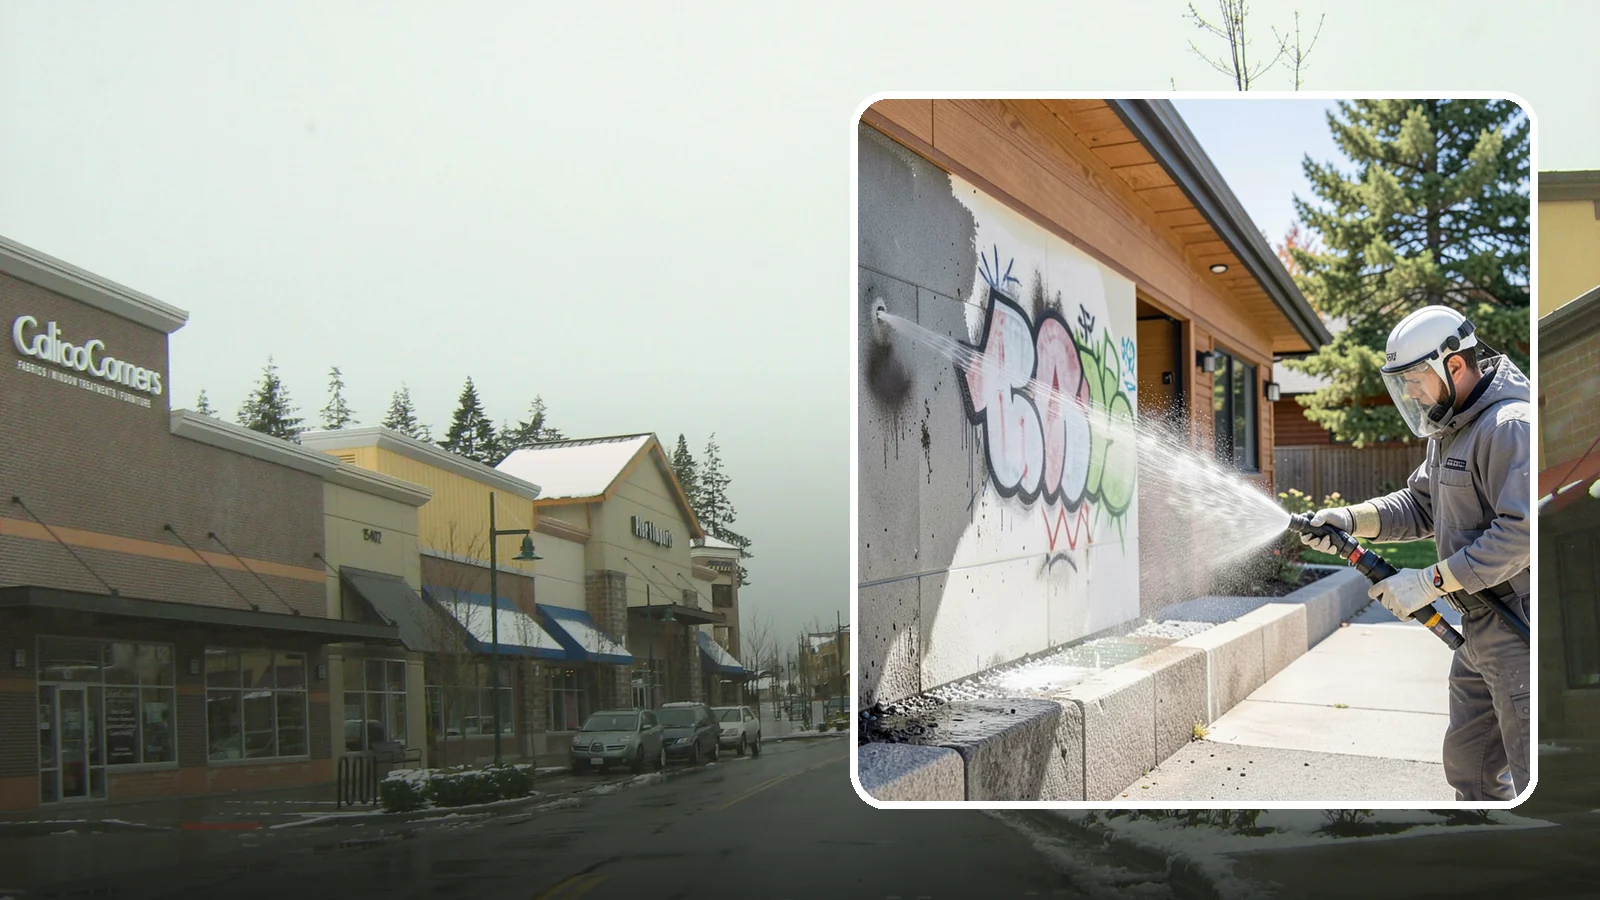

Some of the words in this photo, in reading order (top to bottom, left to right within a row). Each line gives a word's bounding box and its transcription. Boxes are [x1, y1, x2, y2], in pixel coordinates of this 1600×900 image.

[17, 360, 47, 378] FABRICS
[52, 371, 78, 387] WINDOW
[79, 378, 116, 398] TREATMENTS
